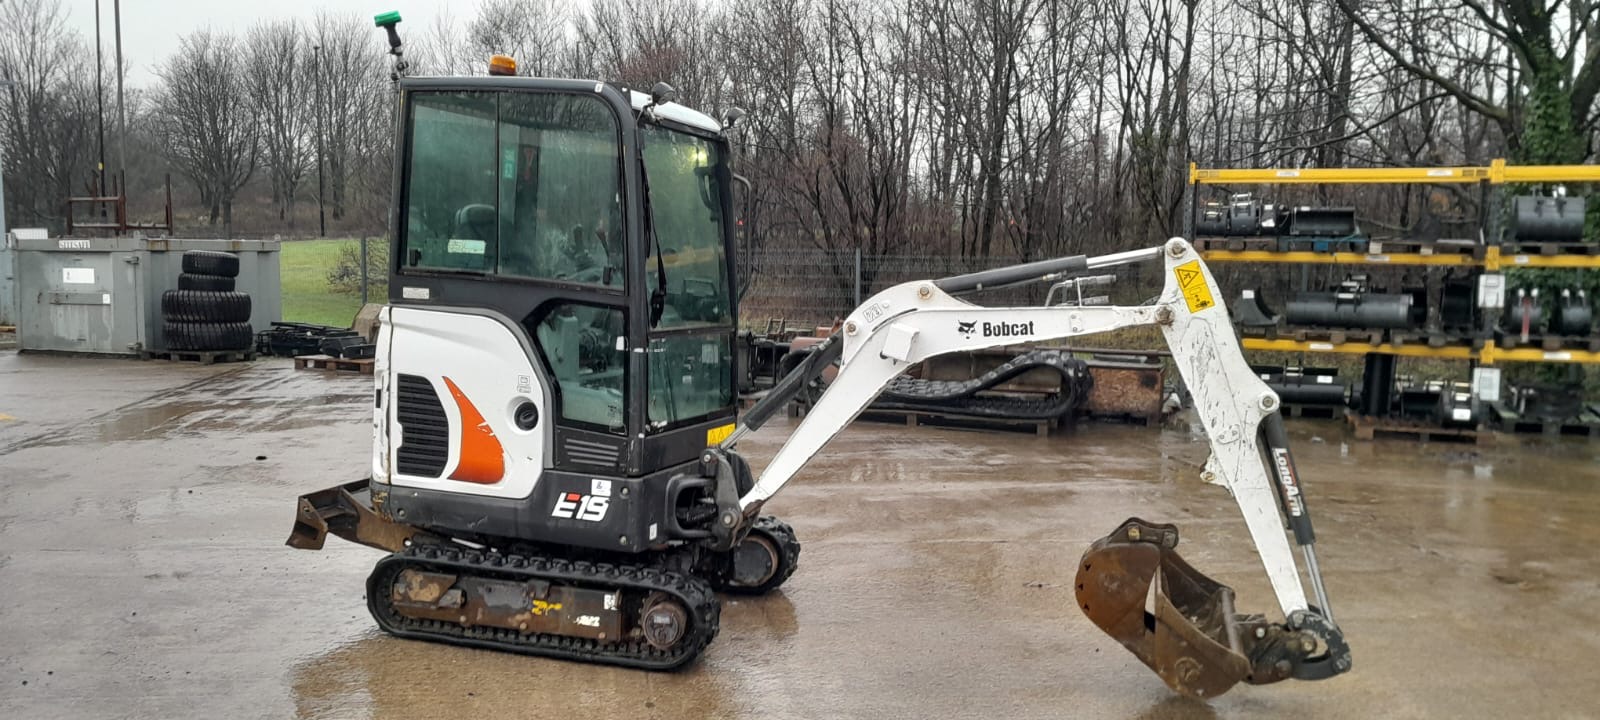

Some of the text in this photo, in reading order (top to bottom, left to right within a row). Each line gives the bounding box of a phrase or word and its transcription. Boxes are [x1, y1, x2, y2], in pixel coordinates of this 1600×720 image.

[983, 321, 1035, 337] Bobcat
[1274, 447, 1302, 517] LongArm
[552, 492, 611, 521] E19
